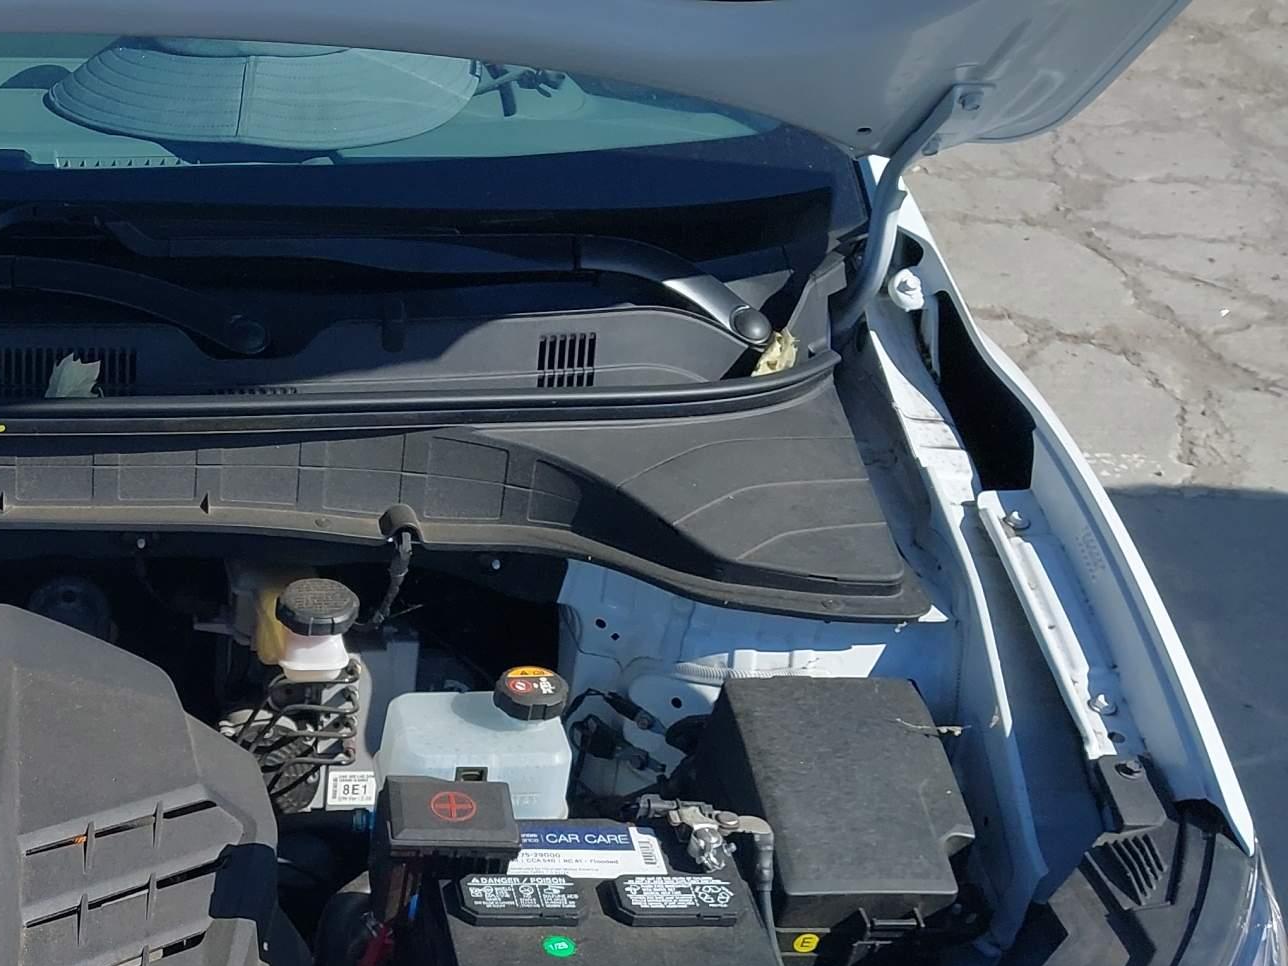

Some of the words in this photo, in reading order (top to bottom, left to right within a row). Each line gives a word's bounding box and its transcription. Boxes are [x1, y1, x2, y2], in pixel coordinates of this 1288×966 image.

[342, 783, 367, 796] 8E1
[545, 833, 581, 844] CAR
[584, 833, 631, 845] CARE
[799, 936, 815, 948] E
